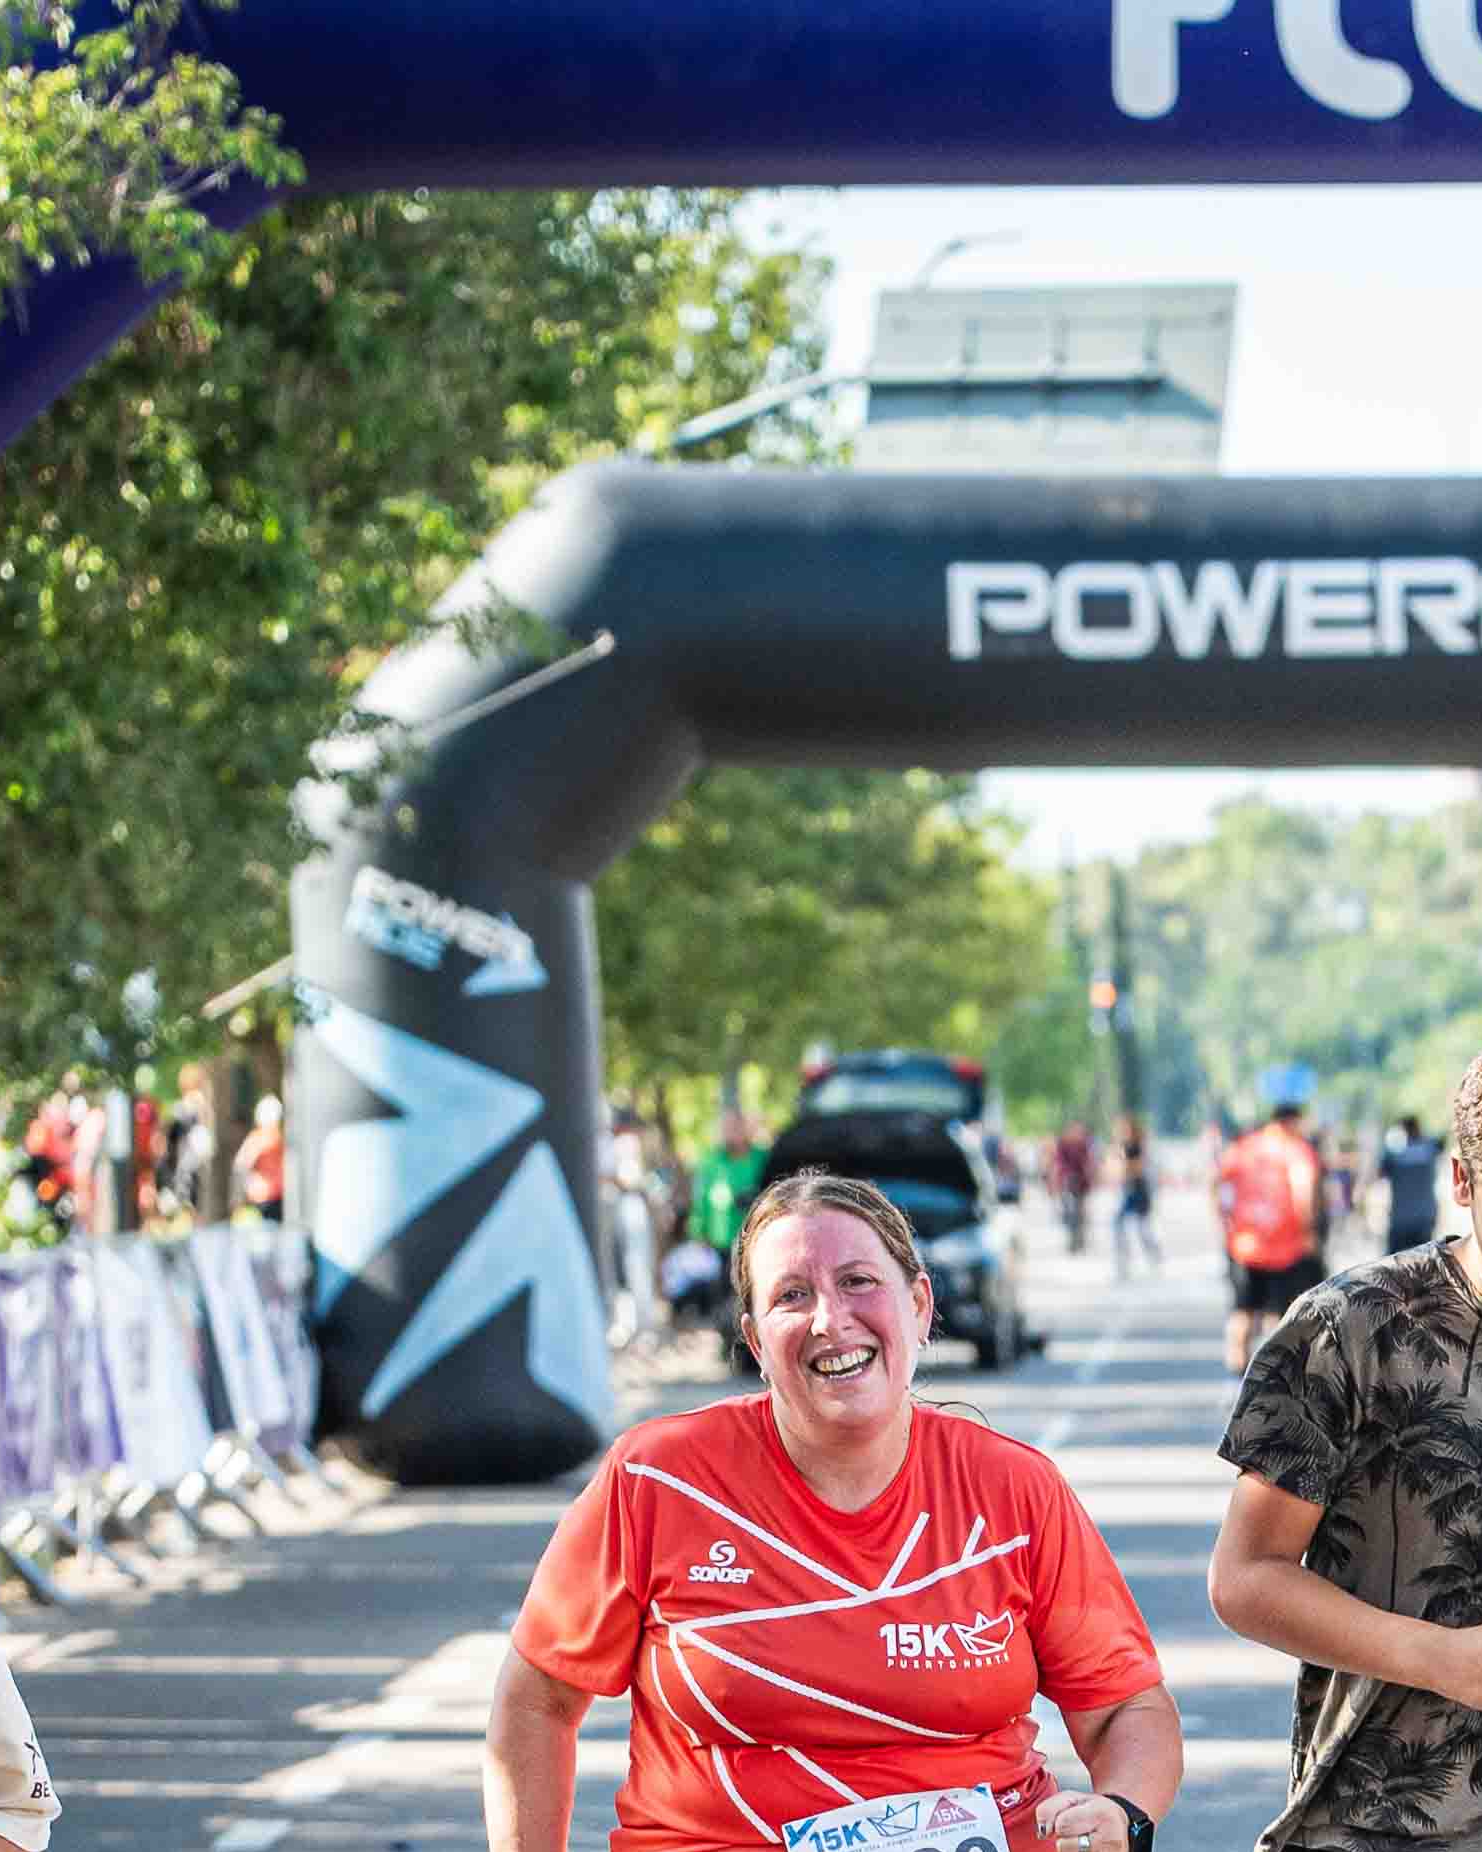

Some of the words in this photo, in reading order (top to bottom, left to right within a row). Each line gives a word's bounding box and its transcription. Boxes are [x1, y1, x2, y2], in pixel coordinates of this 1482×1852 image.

[879, 1623, 955, 1657] 15K
[887, 1658, 957, 1670] PUERTO
[934, 1807, 963, 1822] 15K
